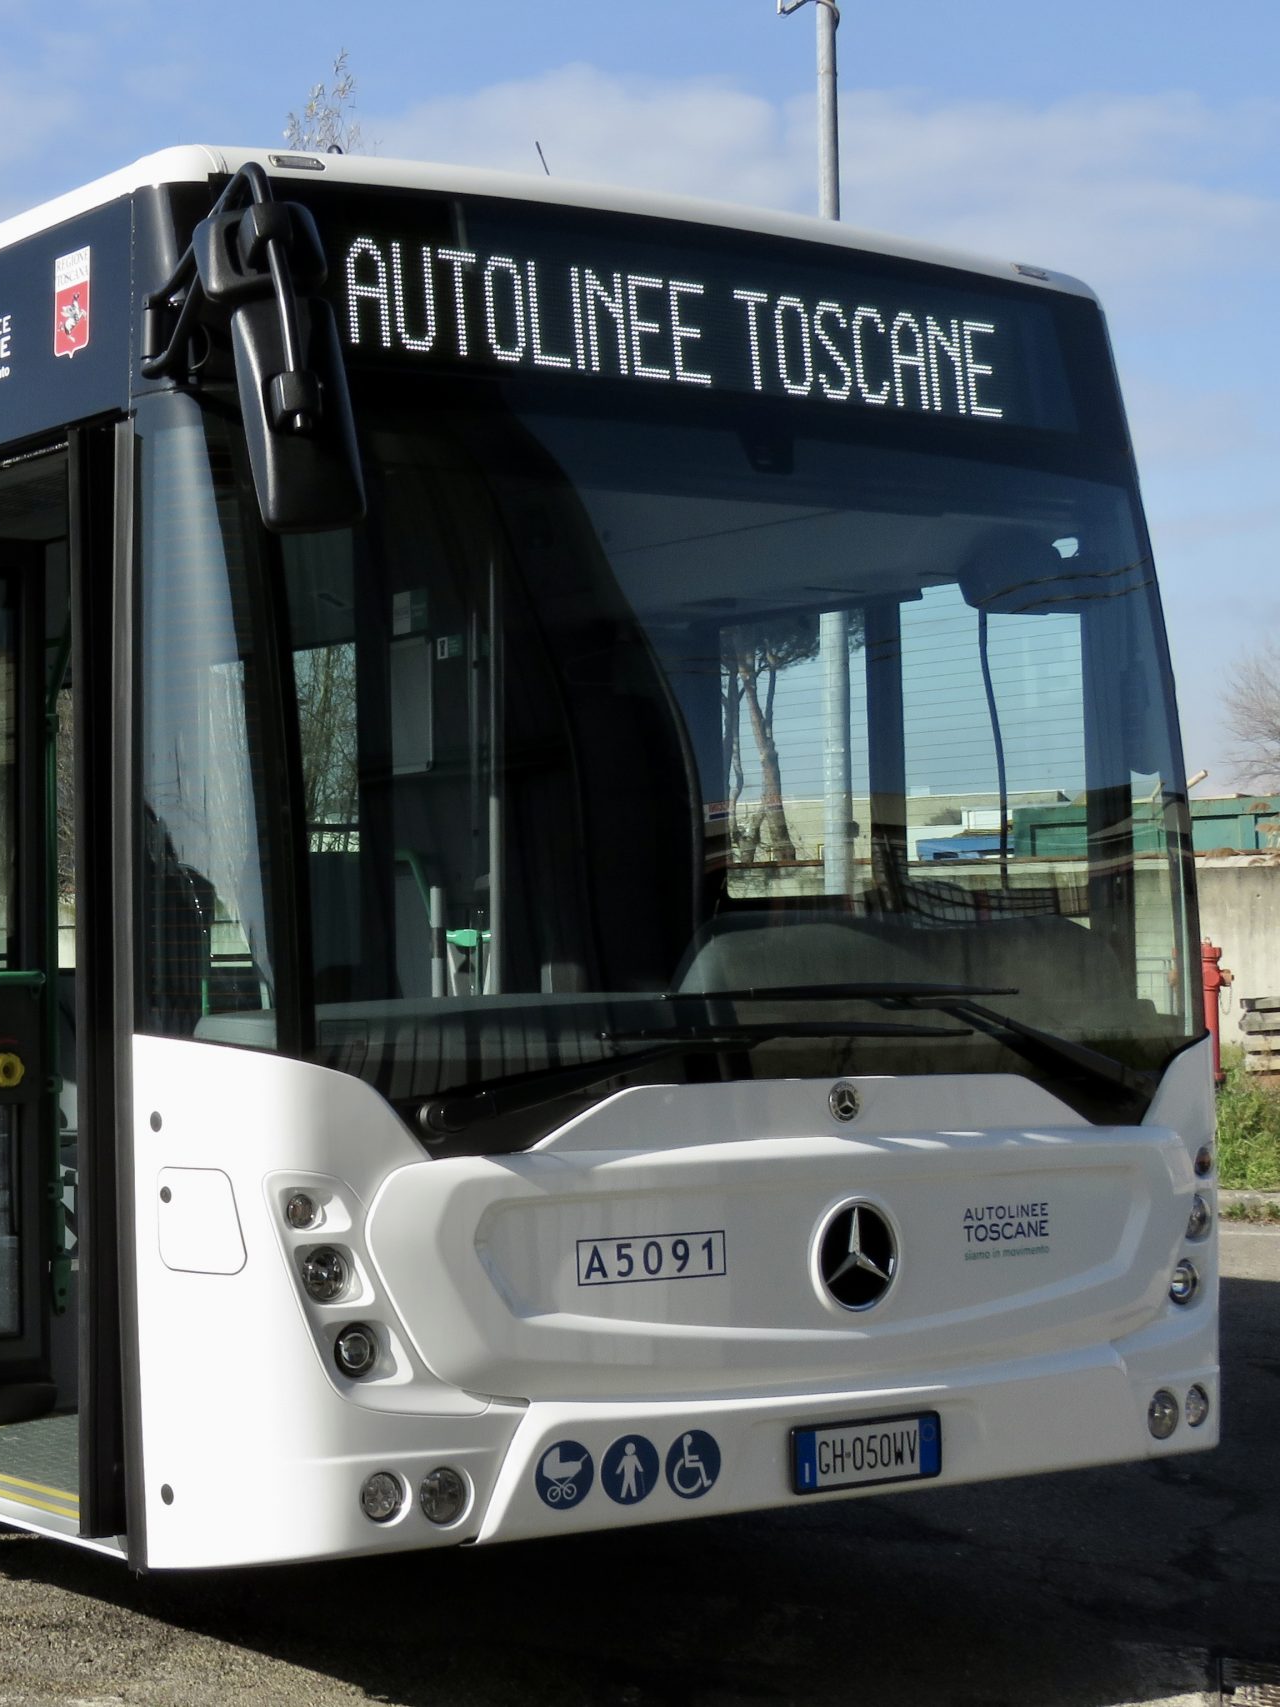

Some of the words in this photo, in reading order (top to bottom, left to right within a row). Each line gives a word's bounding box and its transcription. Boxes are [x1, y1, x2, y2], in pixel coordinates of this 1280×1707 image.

[346, 238, 712, 385] AUTOLINEE
[733, 290, 1003, 418] TOSCANE
[963, 1202, 1049, 1222] AUTOLINEE
[963, 1220, 1050, 1242] TOSCANE
[584, 1237, 714, 1280] A5091
